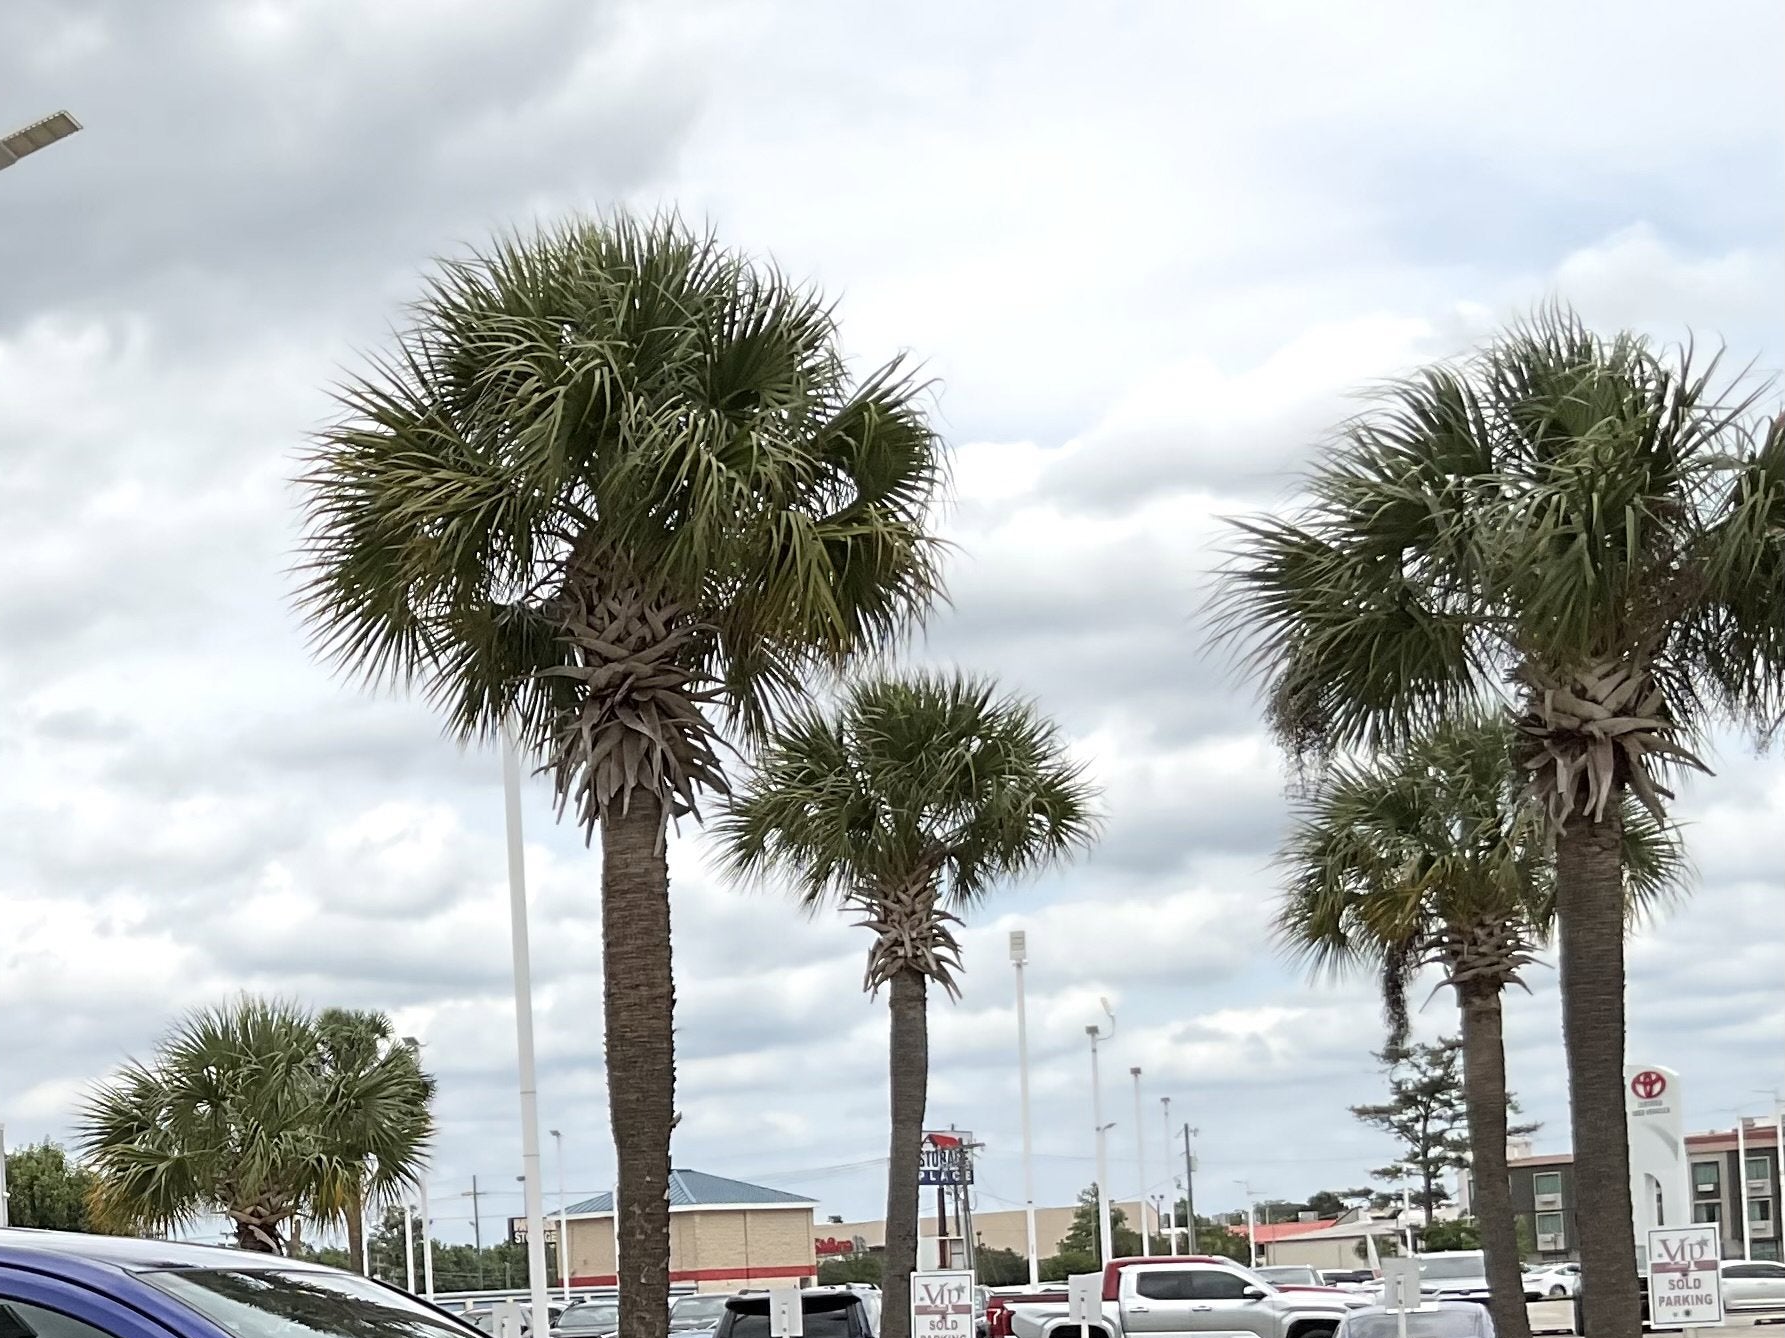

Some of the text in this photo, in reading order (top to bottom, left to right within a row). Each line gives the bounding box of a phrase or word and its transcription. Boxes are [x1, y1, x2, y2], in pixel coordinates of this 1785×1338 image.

[918, 1170, 972, 1182] PLACE
[1668, 1278, 1702, 1291] SOLD
[1658, 1294, 1714, 1307] PARKING
[929, 1319, 959, 1331] SOLD
